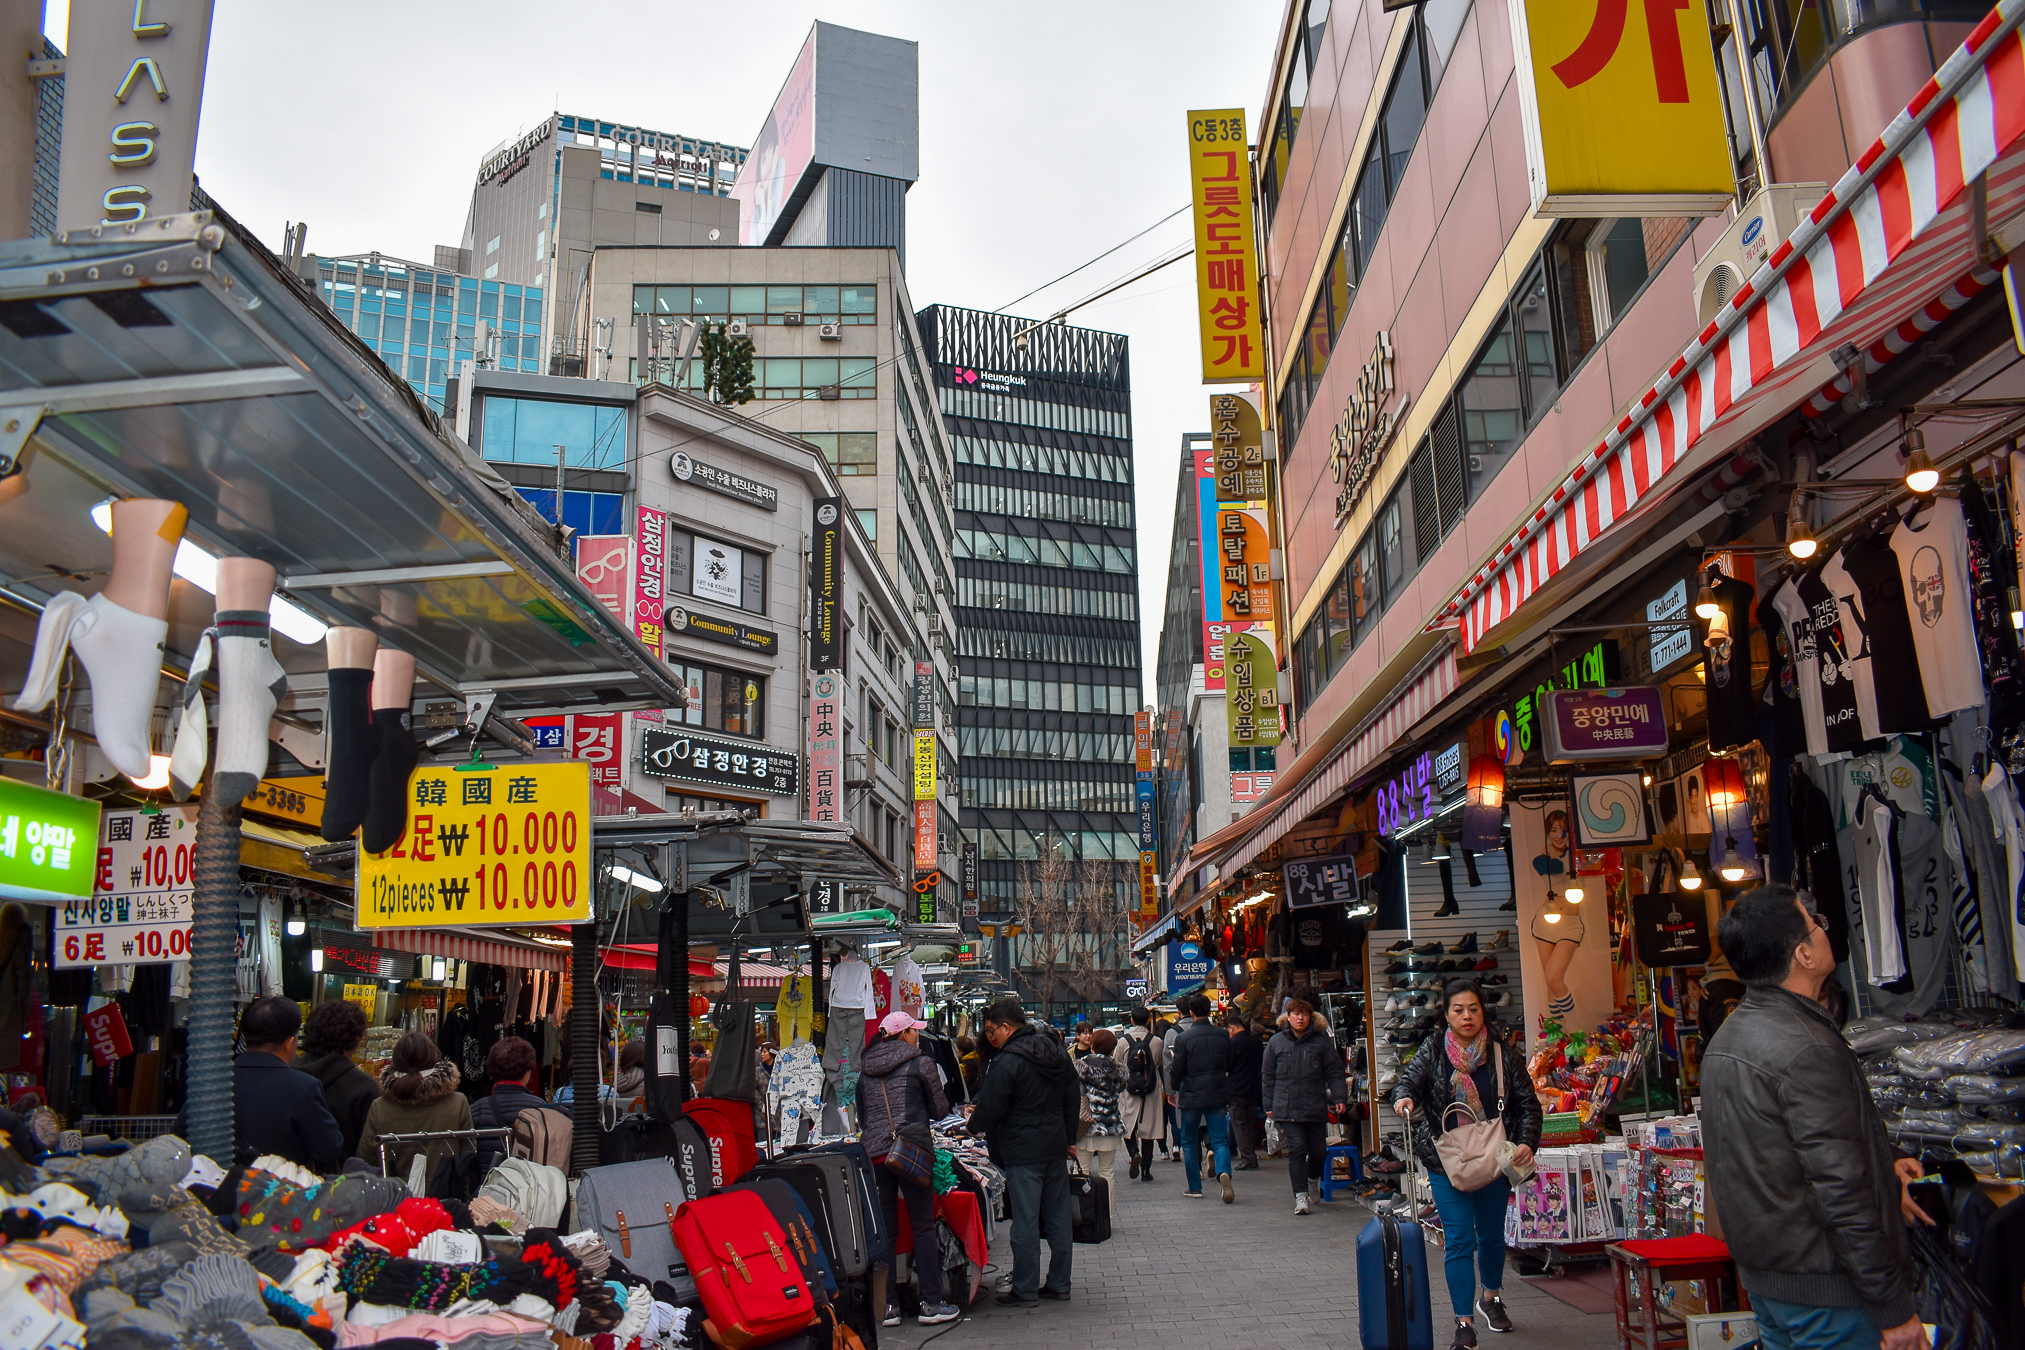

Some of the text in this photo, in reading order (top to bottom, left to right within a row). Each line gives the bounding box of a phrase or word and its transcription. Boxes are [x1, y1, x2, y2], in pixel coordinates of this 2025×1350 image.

[1192, 117, 1243, 142] C동3층
[477, 121, 552, 186] COURTYARD
[609, 127, 748, 165] COURTYARD
[651, 153, 708, 172] Marriott
[980, 370, 1027, 386] Heungkuk
[1214, 396, 1243, 497] 혼수공예
[1246, 447, 1260, 461] 2F
[694, 464, 714, 480] 소공인
[716, 471, 730, 486] 수출
[638, 511, 665, 600] 삼정안경
[1221, 514, 1250, 615] 토탈패션
[820, 530, 836, 645] Community Lounge
[1253, 565, 1267, 579] 1F
[1654, 590, 1680, 619] Folkcraft
[690, 615, 771, 647] Community Lounge
[1228, 635, 1257, 741] 수입상품
[1262, 690, 1274, 705] B1
[816, 702, 834, 738] 中央
[1572, 704, 1650, 728] 중앙민예
[1592, 728, 1635, 741] 中央民藝
[691, 747, 767, 778] 삼정안경
[774, 775, 787, 788] 2층
[1377, 750, 1433, 837] 88 신발
[1142, 802, 1151, 843] 우리은행
[25, 820, 76, 870] 양말
[1288, 864, 1309, 878] 88
[1298, 863, 1353, 903] 신발
[63, 895, 131, 926] 신사양말
[372, 874, 436, 919] 12pieces
[1174, 962, 1208, 973] 우리은행
[709, 1136, 723, 1189] Supre
